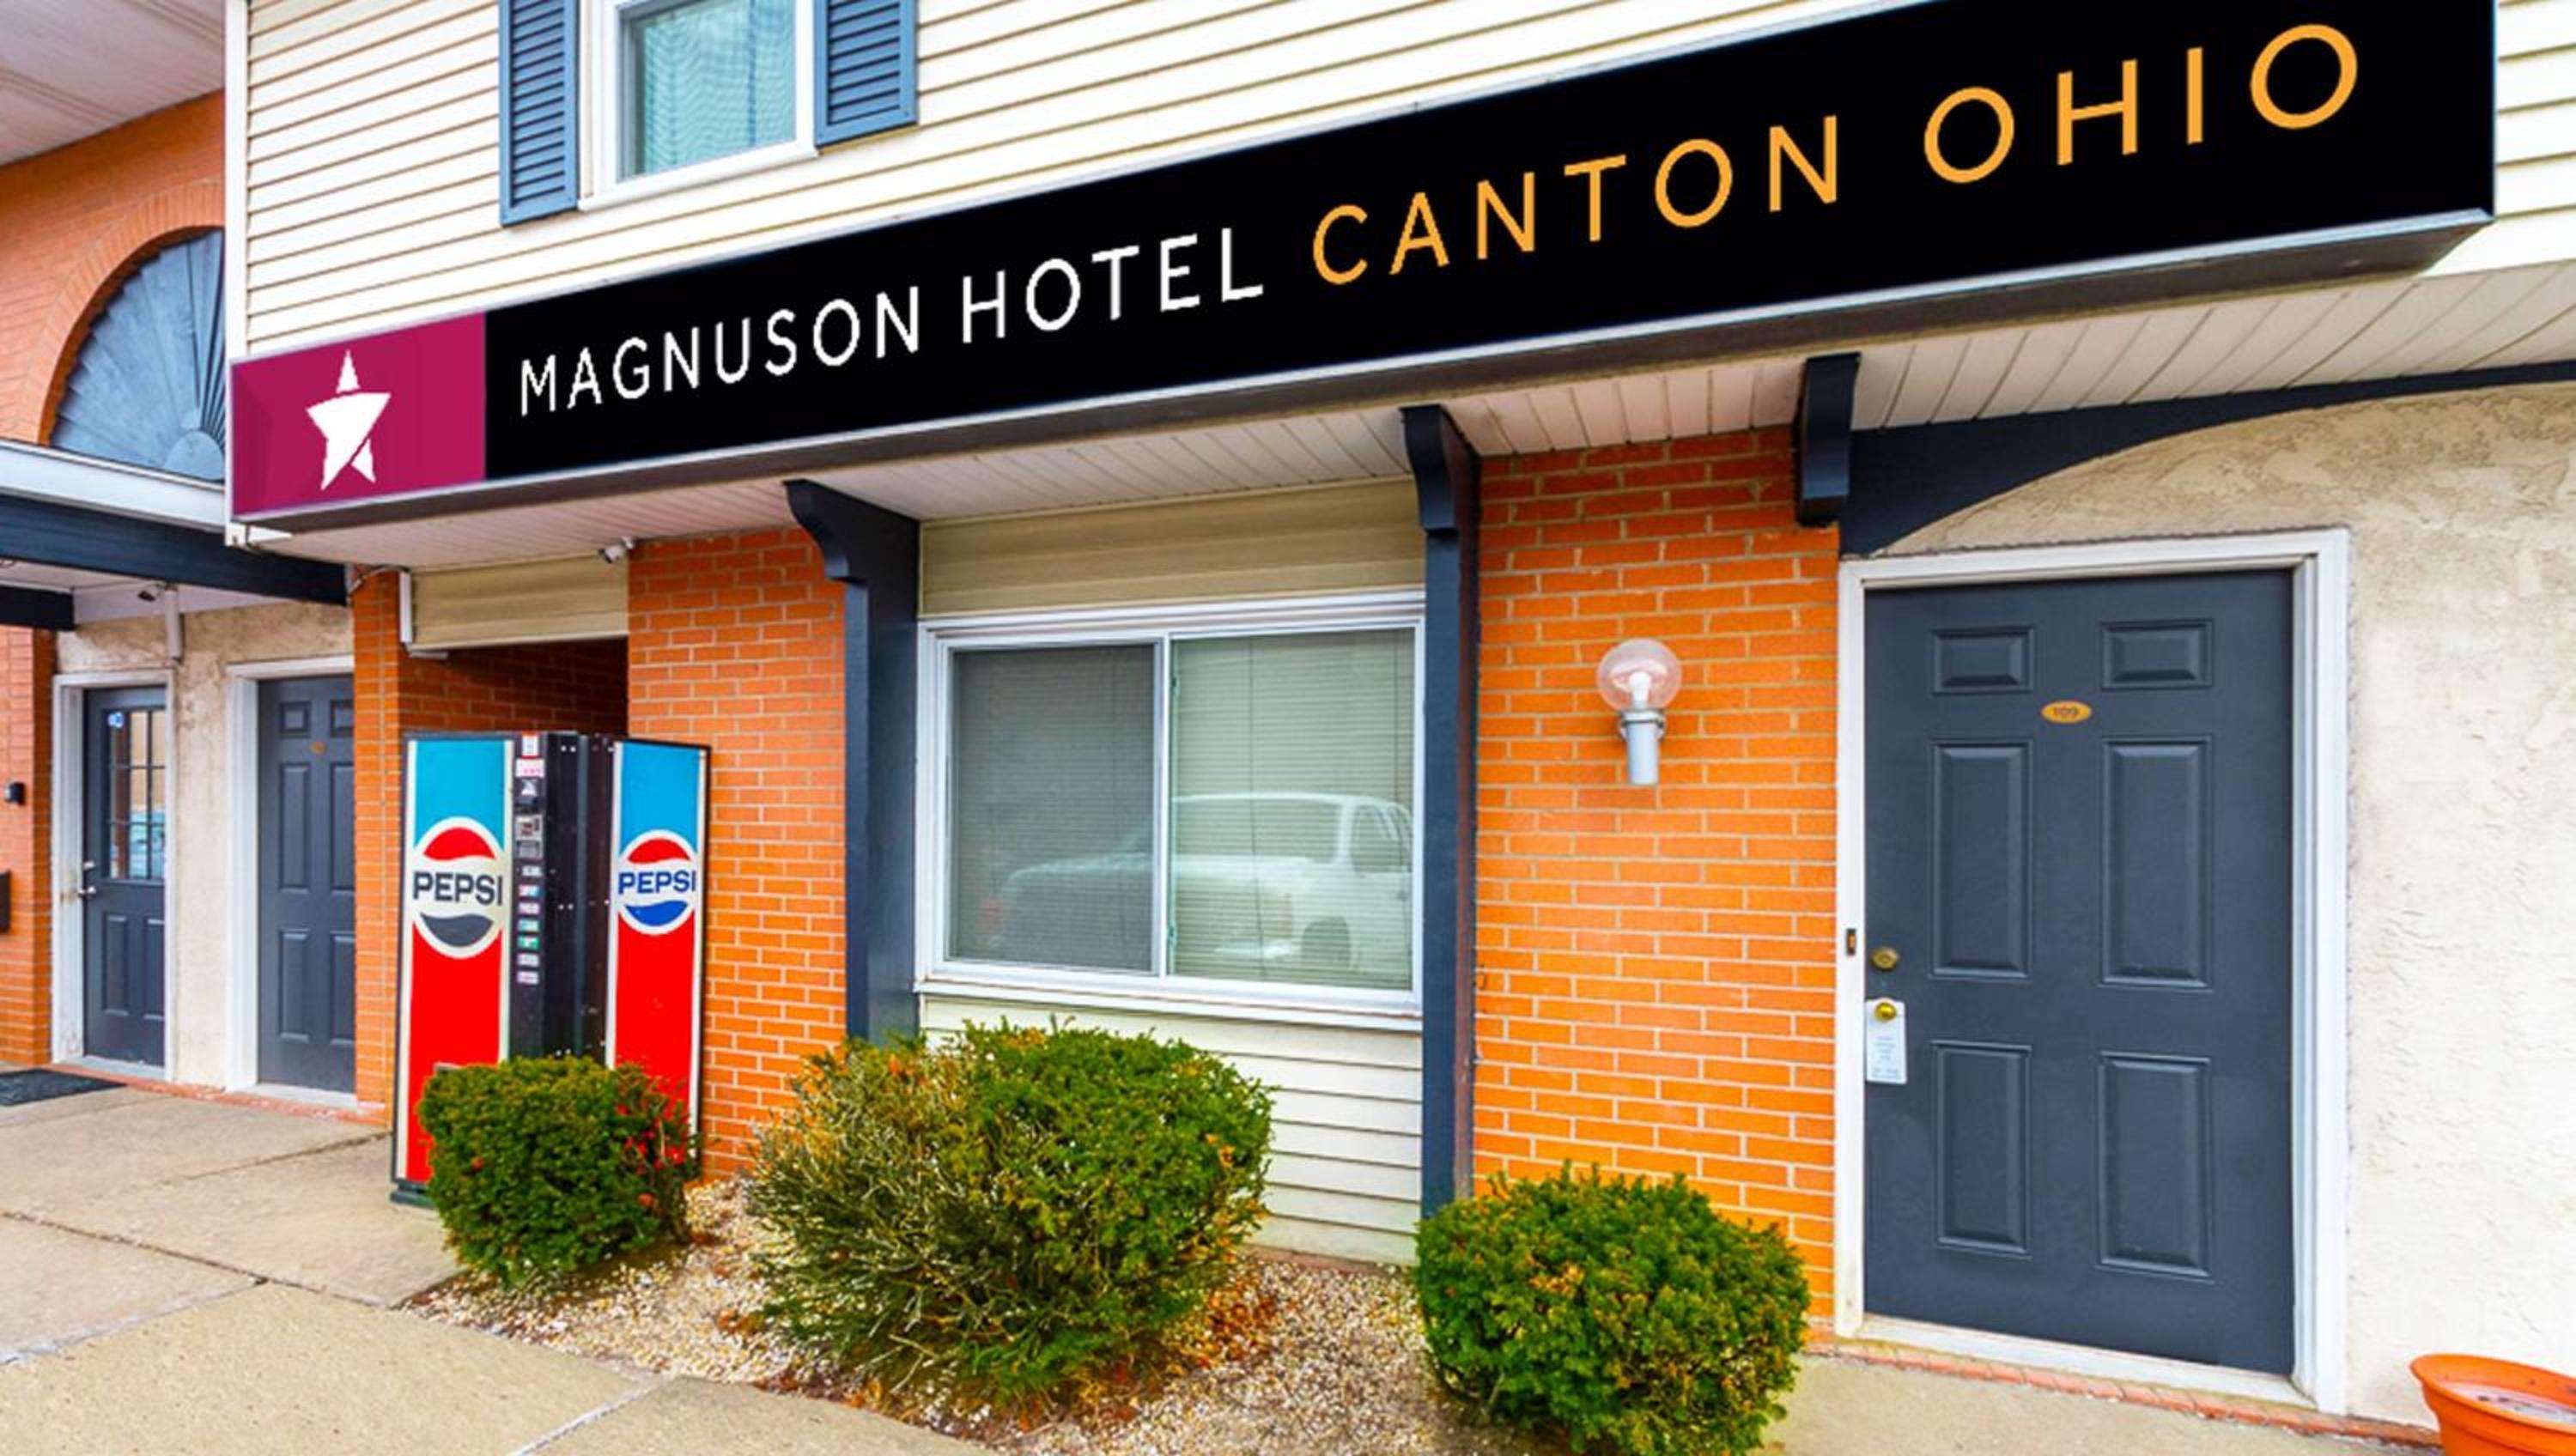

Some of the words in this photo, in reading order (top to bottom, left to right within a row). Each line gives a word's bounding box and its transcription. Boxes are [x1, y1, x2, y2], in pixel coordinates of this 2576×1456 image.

[520, 286, 919, 416] MAGNUSON
[963, 228, 1264, 343] HOTEL
[1313, 115, 1838, 285] CANTON
[1923, 24, 2358, 184] OHIO
[412, 871, 503, 906] PEPSI
[617, 869, 696, 895] PEPSI
